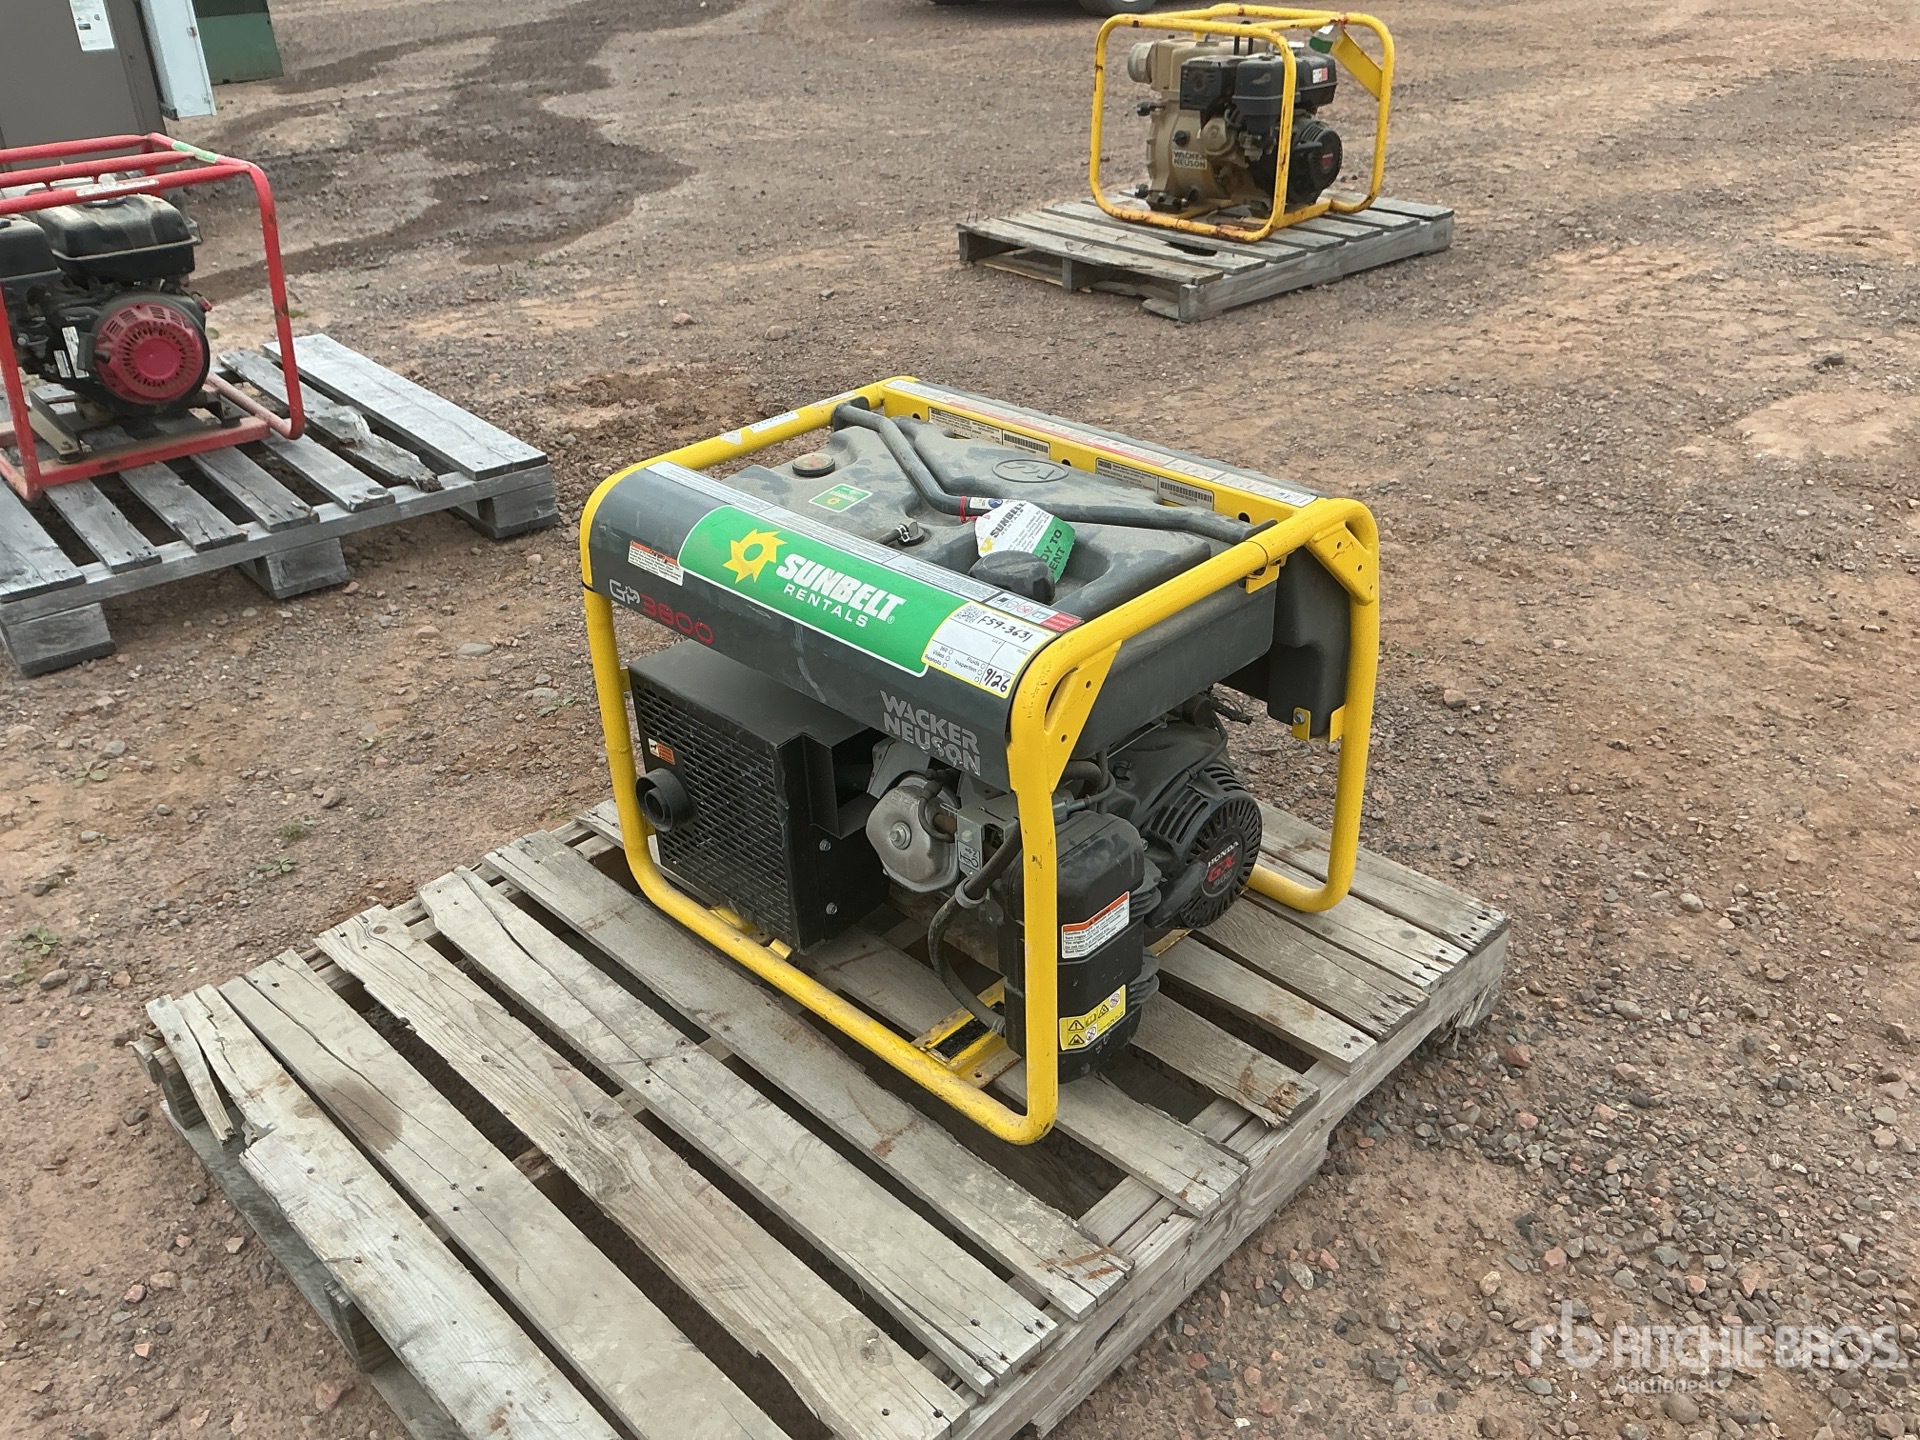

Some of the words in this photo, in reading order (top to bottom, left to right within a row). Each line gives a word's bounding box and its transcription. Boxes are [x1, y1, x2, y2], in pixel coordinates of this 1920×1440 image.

[1173, 158, 1206, 168] NEUSON
[990, 502, 1027, 539] SUNBELT
[1050, 529, 1063, 545] TO
[783, 583, 869, 628] RENTALS
[954, 659, 978, 673] Inspection
[966, 656, 980, 667] Fluids
[986, 667, 1011, 693] 9/26
[880, 689, 980, 755] WACKER
[883, 711, 981, 777] NEUSON
[1207, 841, 1239, 868] HONDA
